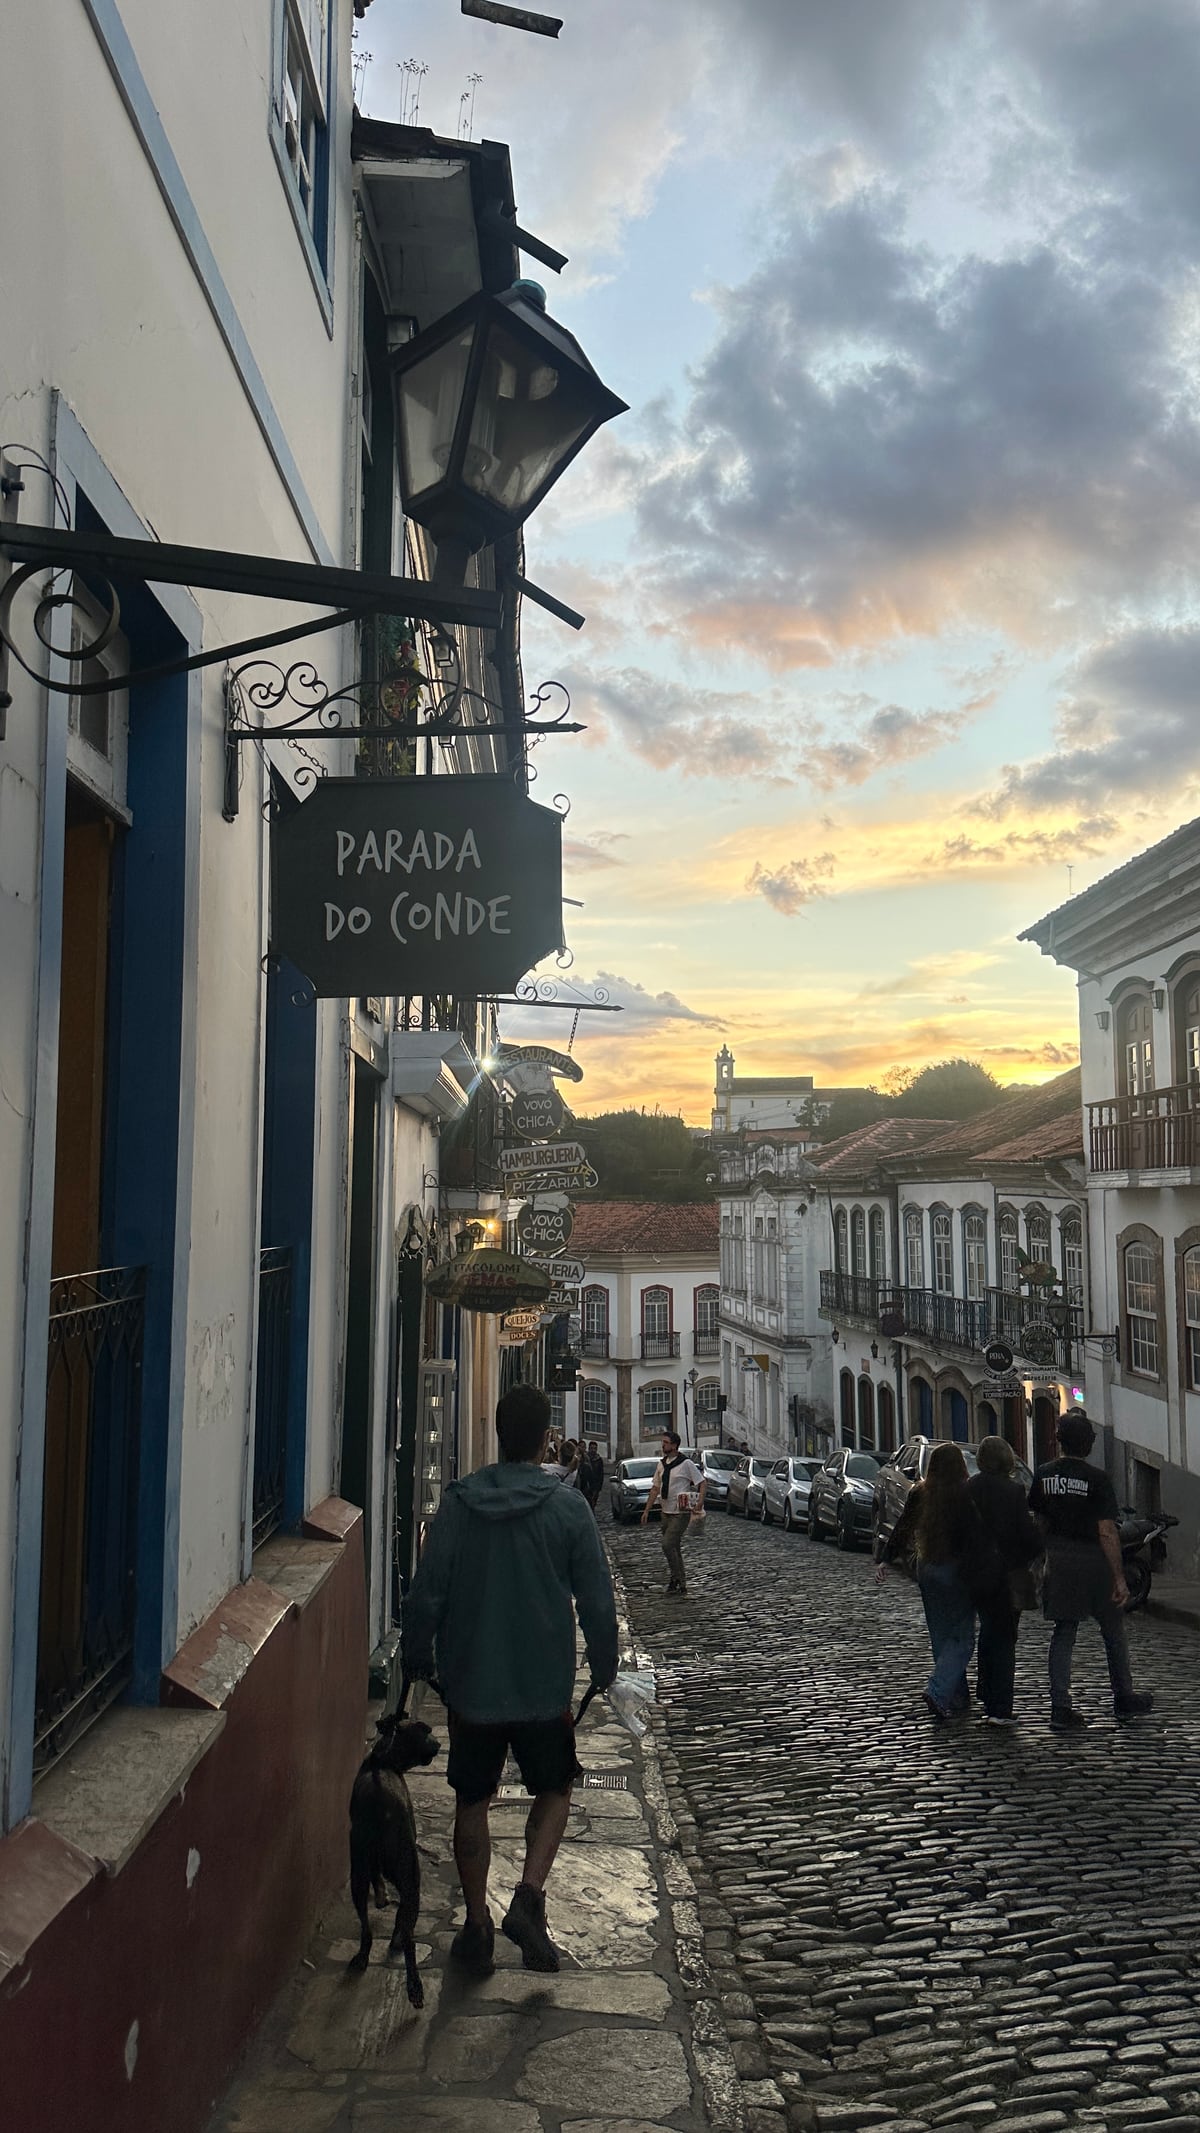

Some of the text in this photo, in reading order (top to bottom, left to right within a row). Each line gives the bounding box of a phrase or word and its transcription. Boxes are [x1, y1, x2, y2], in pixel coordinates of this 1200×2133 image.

[335, 828, 482, 876] PARADA
[523, 1096, 553, 1111] VOVÓ
[516, 1115, 555, 1129] CHICA
[499, 1147, 582, 1169] HAMBURGUERIA
[512, 1176, 581, 1193] PIZZARIA
[529, 1213, 564, 1227] VOVÓ
[522, 1227, 565, 1242] CHICA
[454, 1262, 521, 1274] ITACOLOMI
[507, 1315, 537, 1327] QUEIJOS
[510, 1331, 537, 1340] DOCES
[1041, 1474, 1067, 1495] TITÃS
